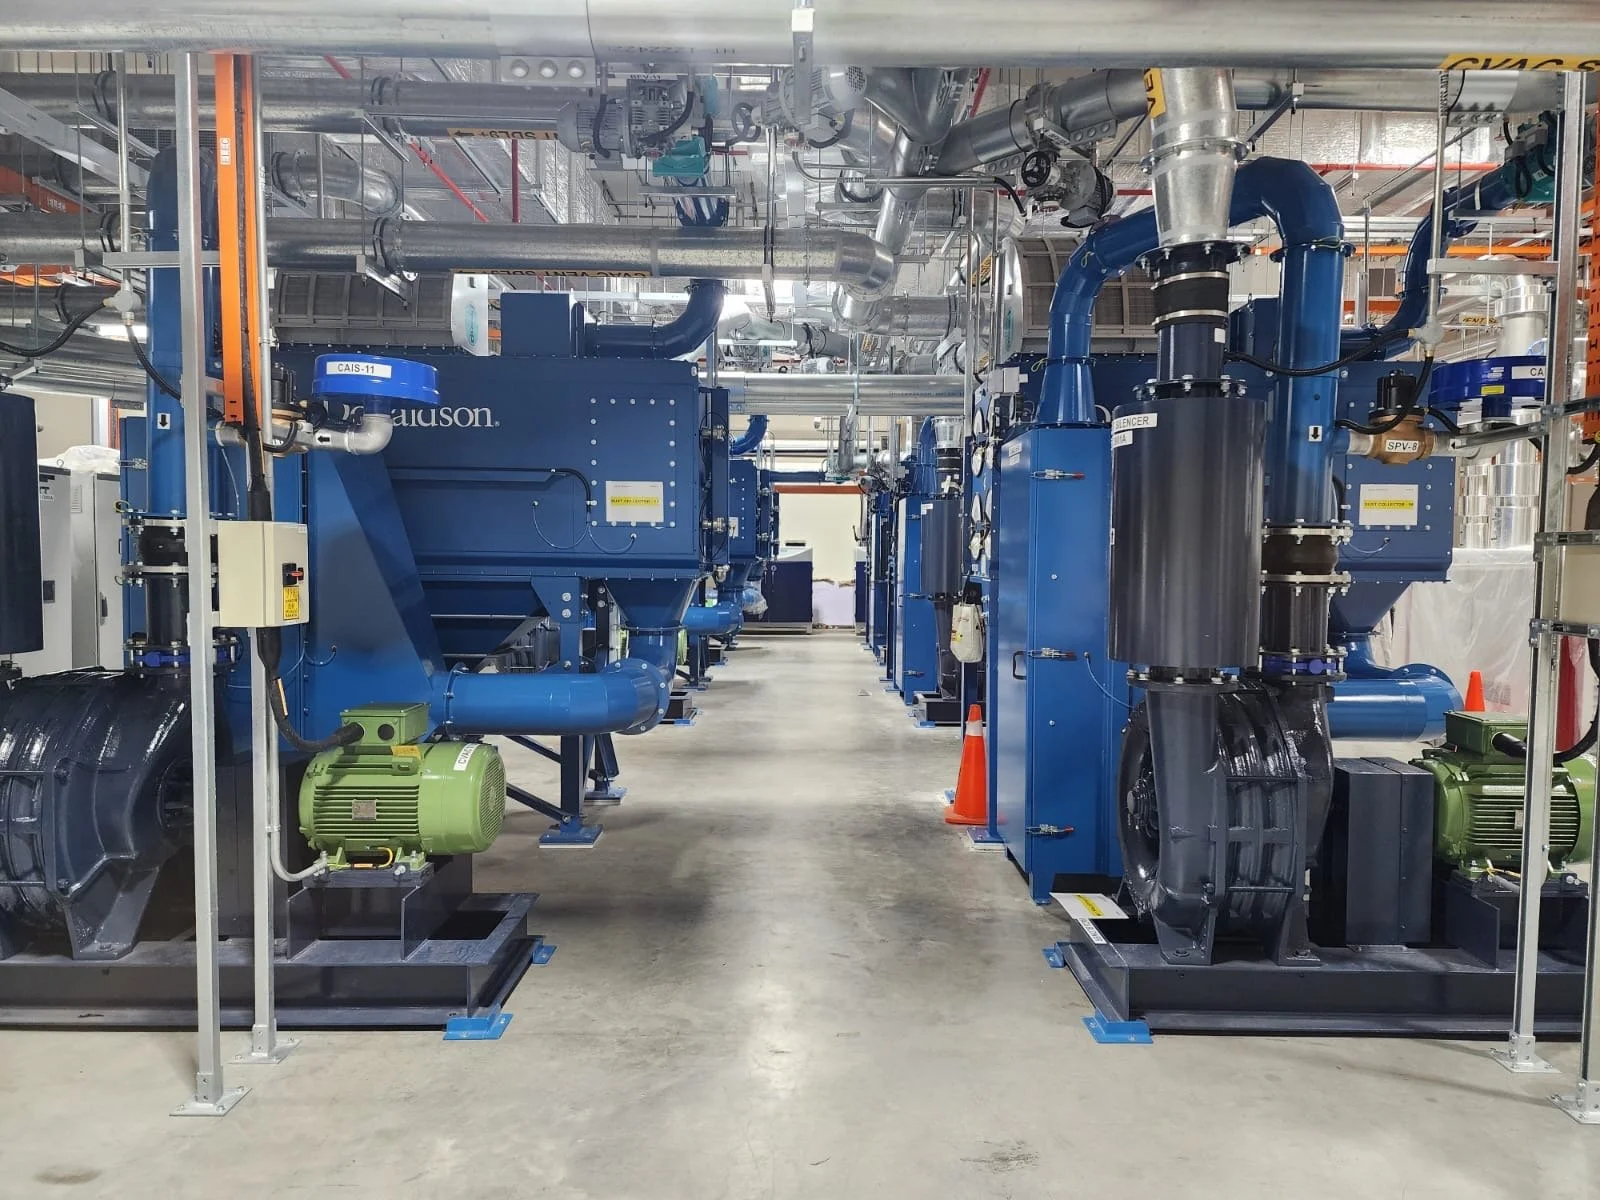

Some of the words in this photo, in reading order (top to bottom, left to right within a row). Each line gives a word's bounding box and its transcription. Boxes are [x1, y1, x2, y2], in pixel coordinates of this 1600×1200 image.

[337, 363, 375, 375] CAIS-11
[1529, 367, 1545, 377] CA
[1387, 441, 1418, 451] SPV-8
